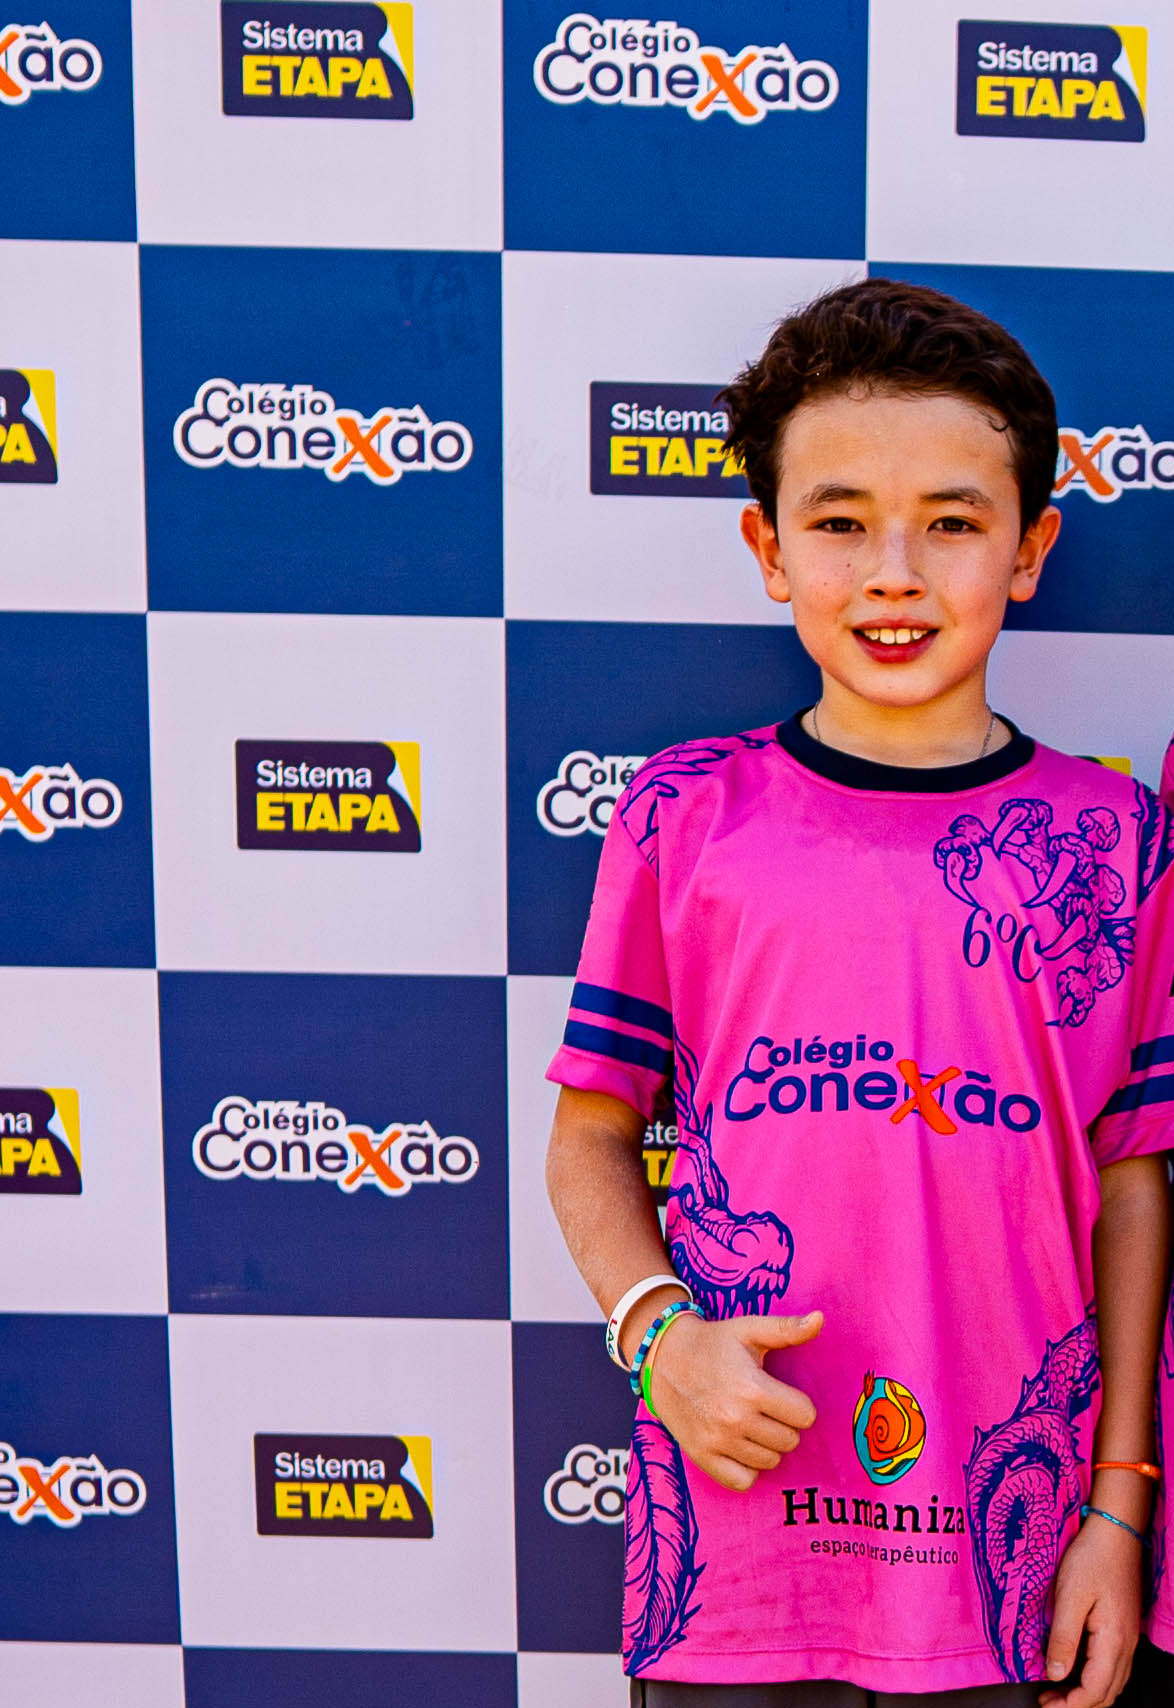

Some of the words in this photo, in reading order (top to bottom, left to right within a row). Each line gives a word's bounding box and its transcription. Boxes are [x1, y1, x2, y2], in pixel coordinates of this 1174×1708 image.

[242, 20, 363, 52] Sistema
[564, 21, 692, 55] Colégio
[977, 41, 1097, 74] Sistema
[242, 55, 393, 99] ETAPA
[975, 76, 1126, 122] ETAPA
[203, 386, 326, 420] Colégio
[611, 403, 729, 432] Sistema
[257, 759, 371, 789] Sistema
[566, 758, 635, 791] Colé
[257, 792, 400, 833] ETAPA
[745, 1034, 894, 1083] Colégio
[220, 1105, 339, 1136] Colégio
[275, 1453, 386, 1480] Sistema
[0, 1463, 140, 1520] eXão
[276, 1483, 413, 1522] ETAPA
[782, 1487, 965, 1534] Humaniza
[811, 1538, 866, 1558] espaço
